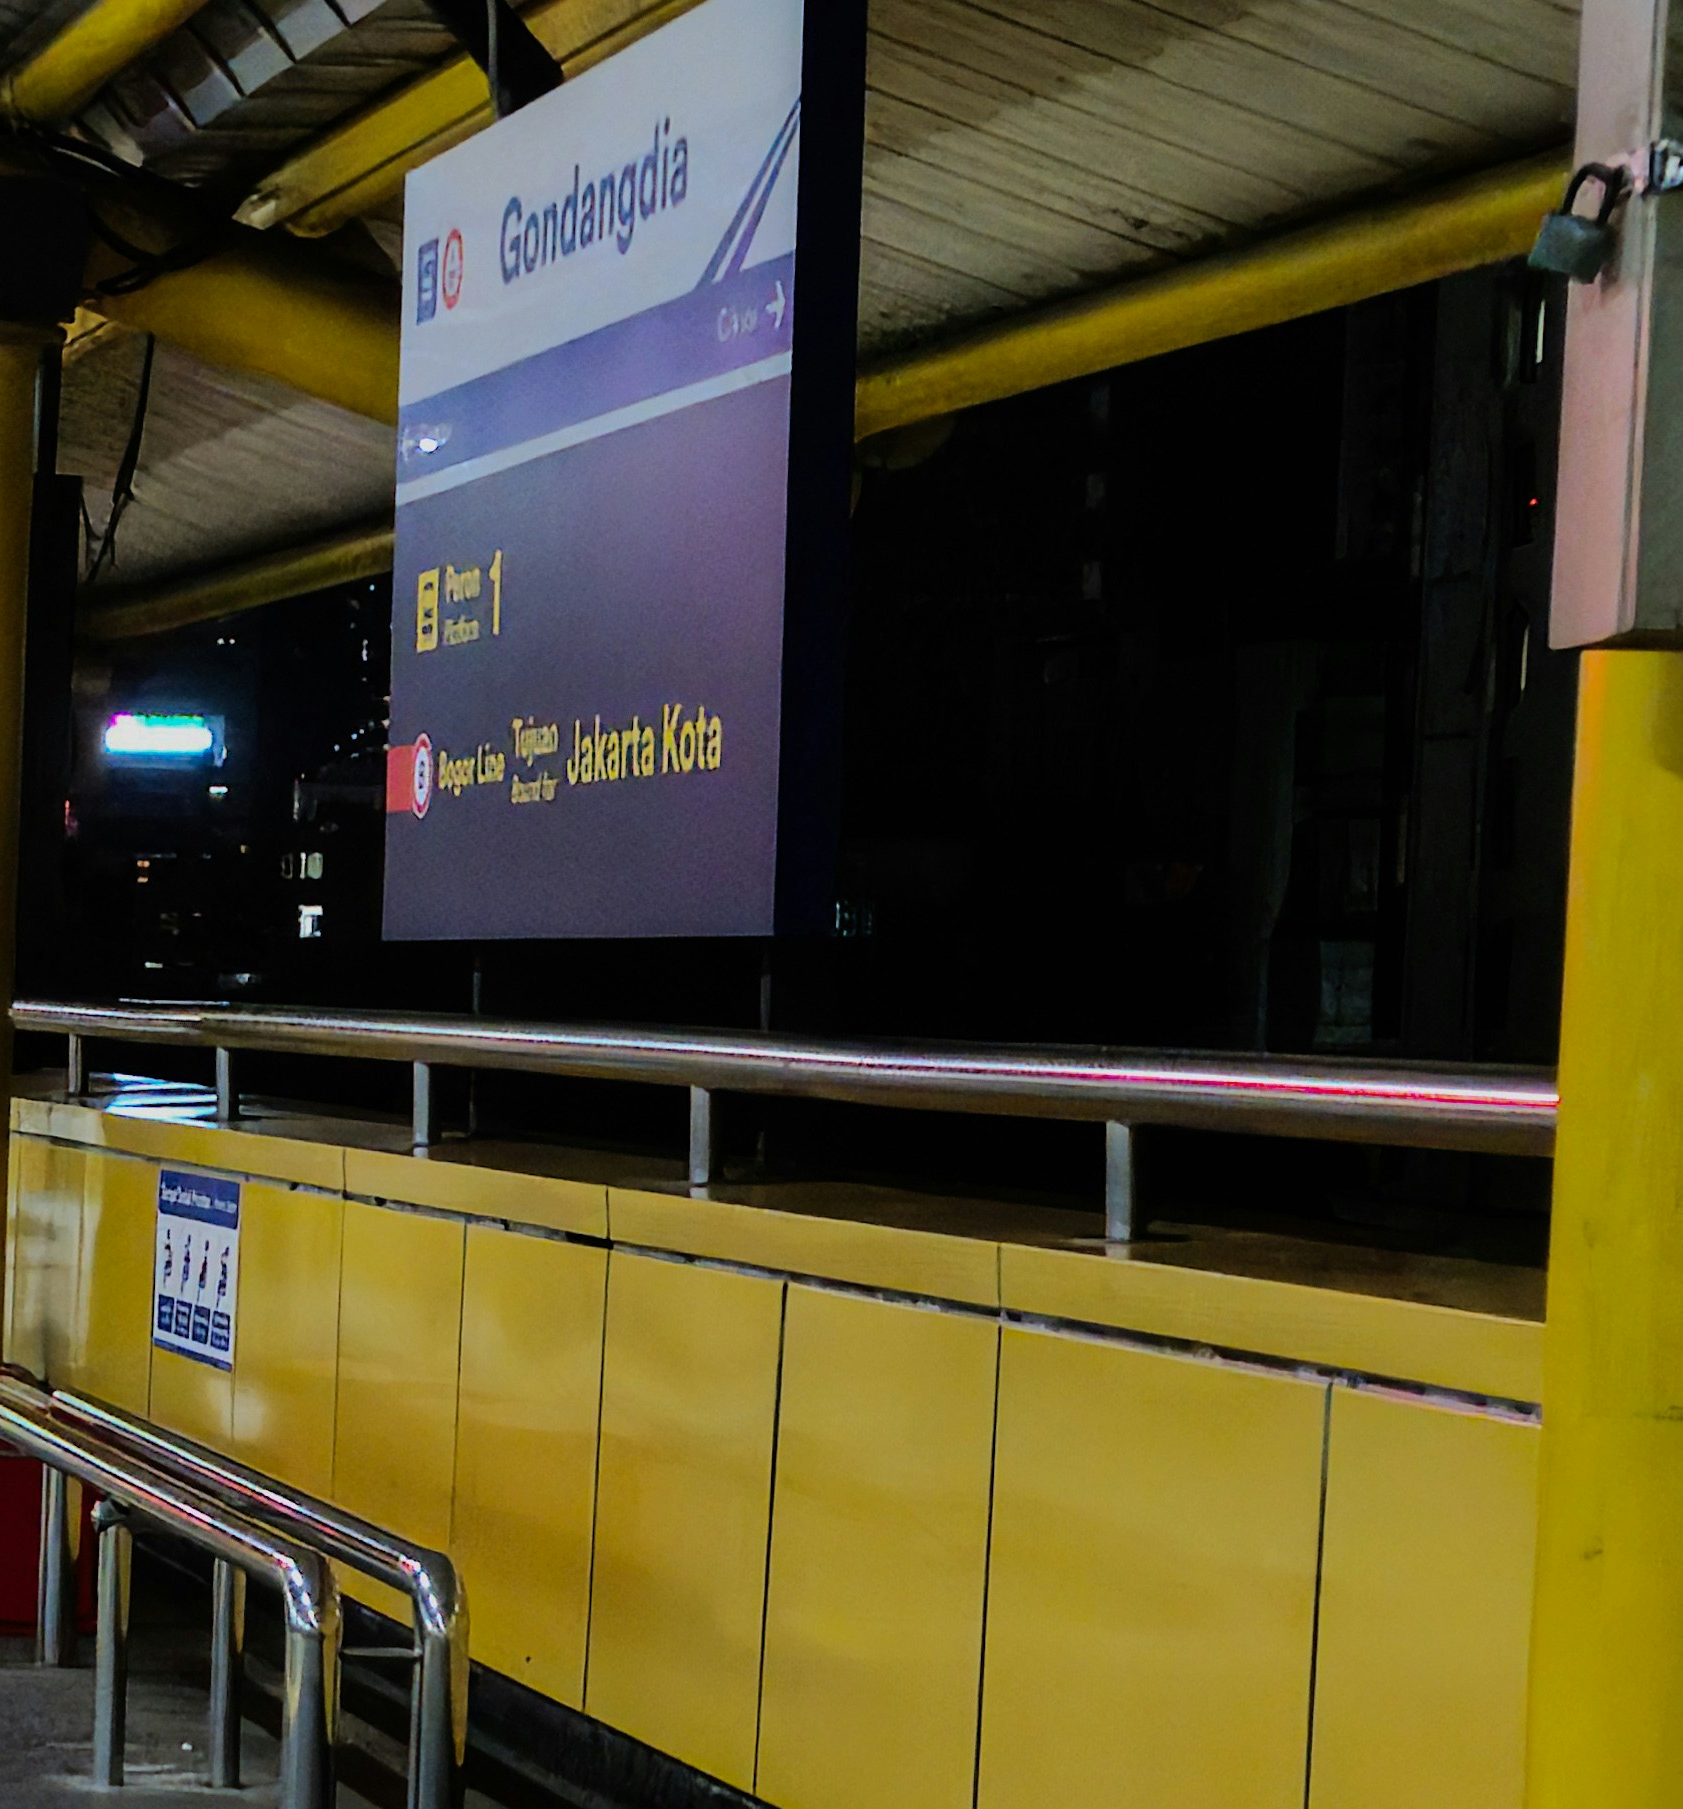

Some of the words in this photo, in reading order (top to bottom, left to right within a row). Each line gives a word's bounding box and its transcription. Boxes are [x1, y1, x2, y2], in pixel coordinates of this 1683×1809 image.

[500, 116, 688, 285] Gondangdia
[489, 549, 502, 635] 1
[566, 714, 655, 785] Jakarta
[661, 703, 722, 774] Kota
